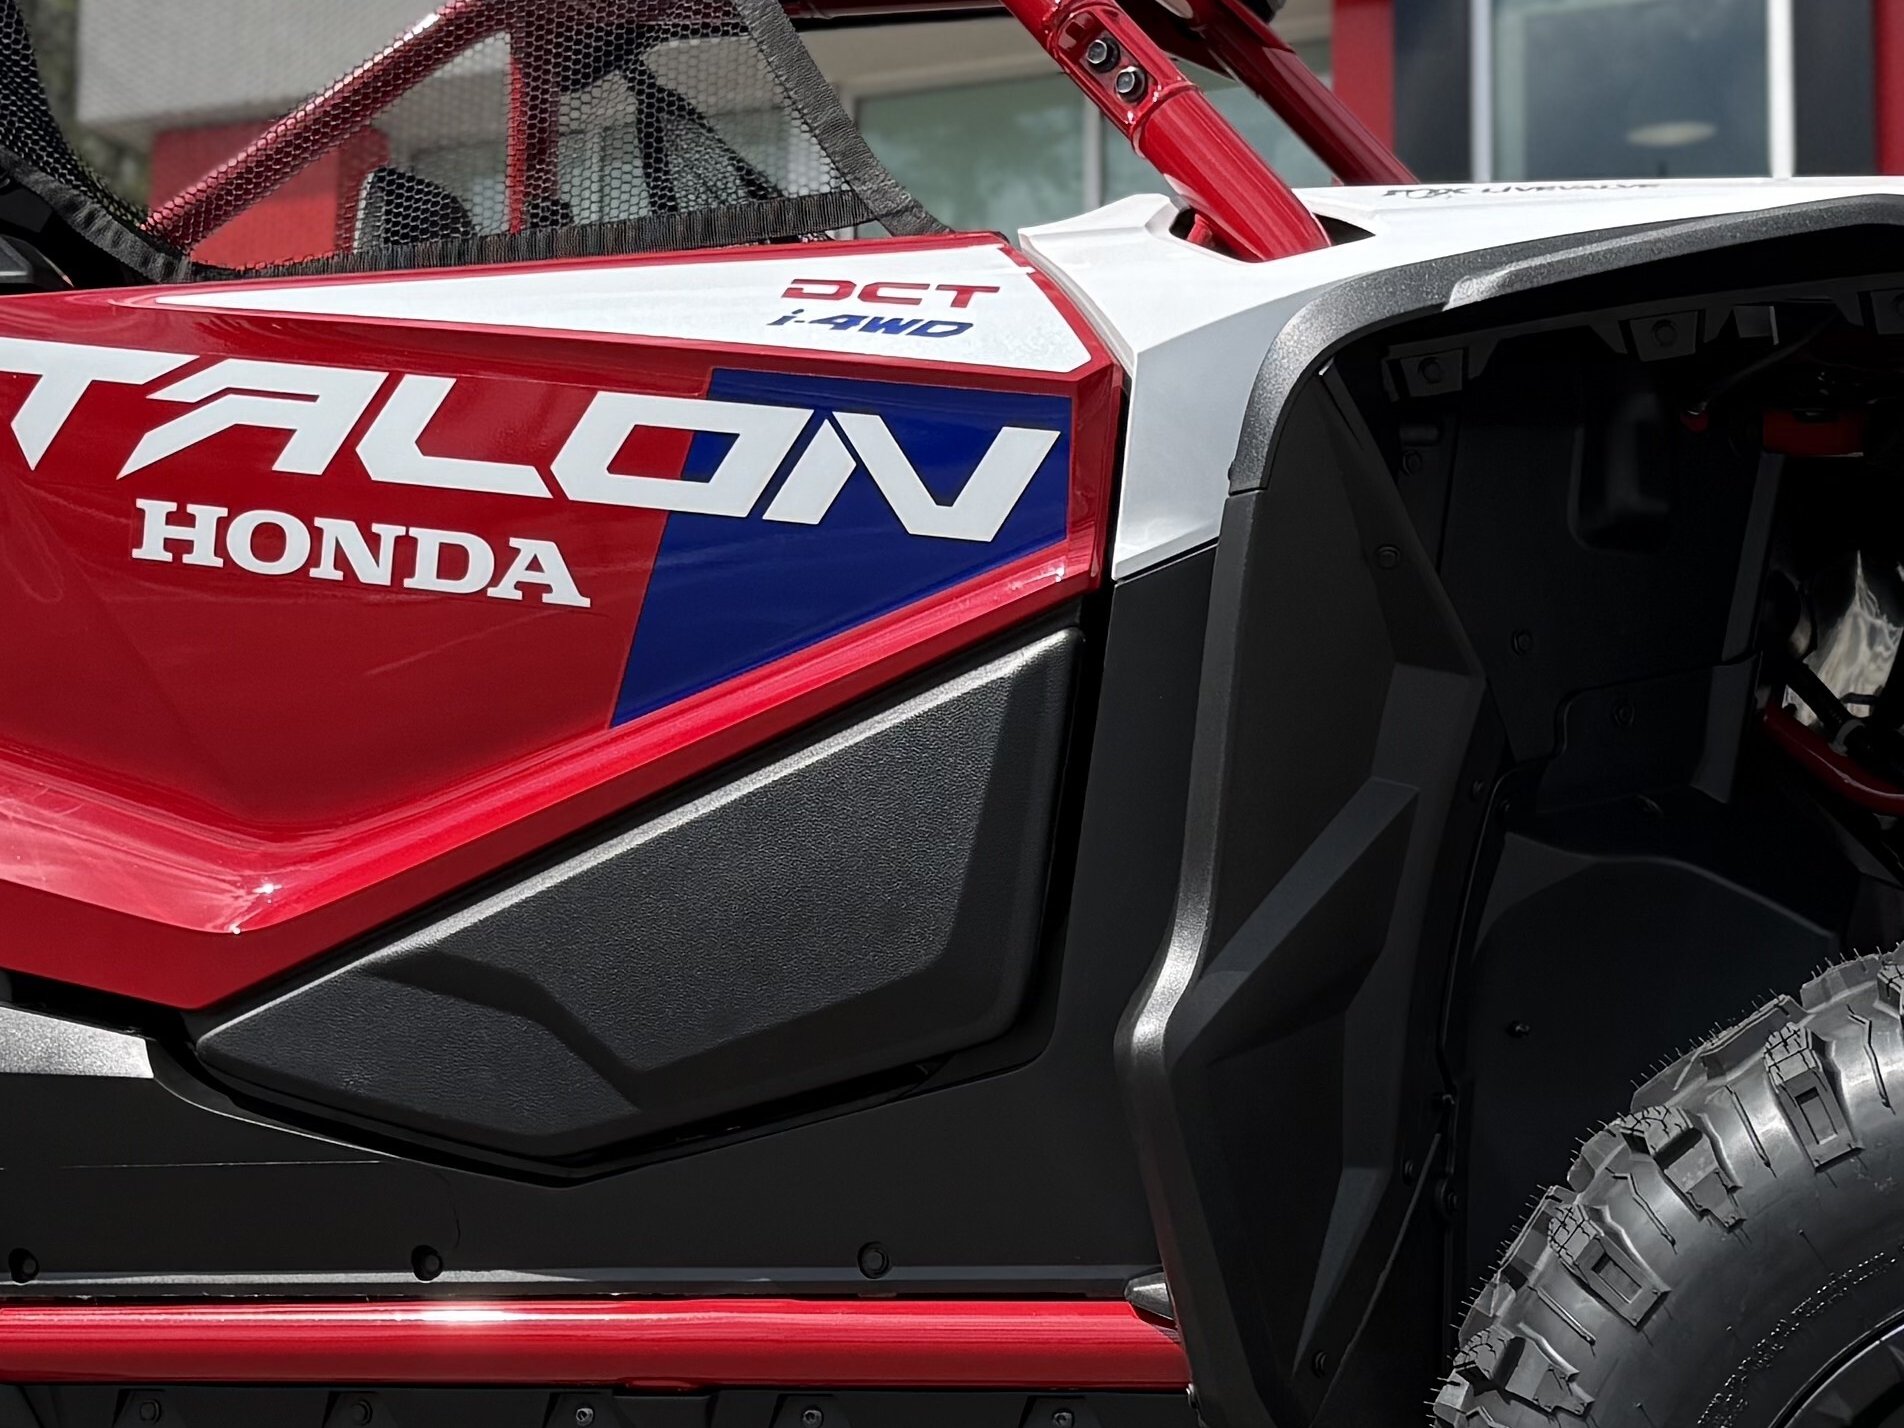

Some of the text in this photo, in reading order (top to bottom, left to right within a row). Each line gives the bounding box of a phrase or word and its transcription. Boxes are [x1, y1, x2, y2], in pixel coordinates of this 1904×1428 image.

[781, 278, 1001, 309] DCT
[767, 308, 974, 339] i-4WD
[132, 498, 592, 609] HONDA
